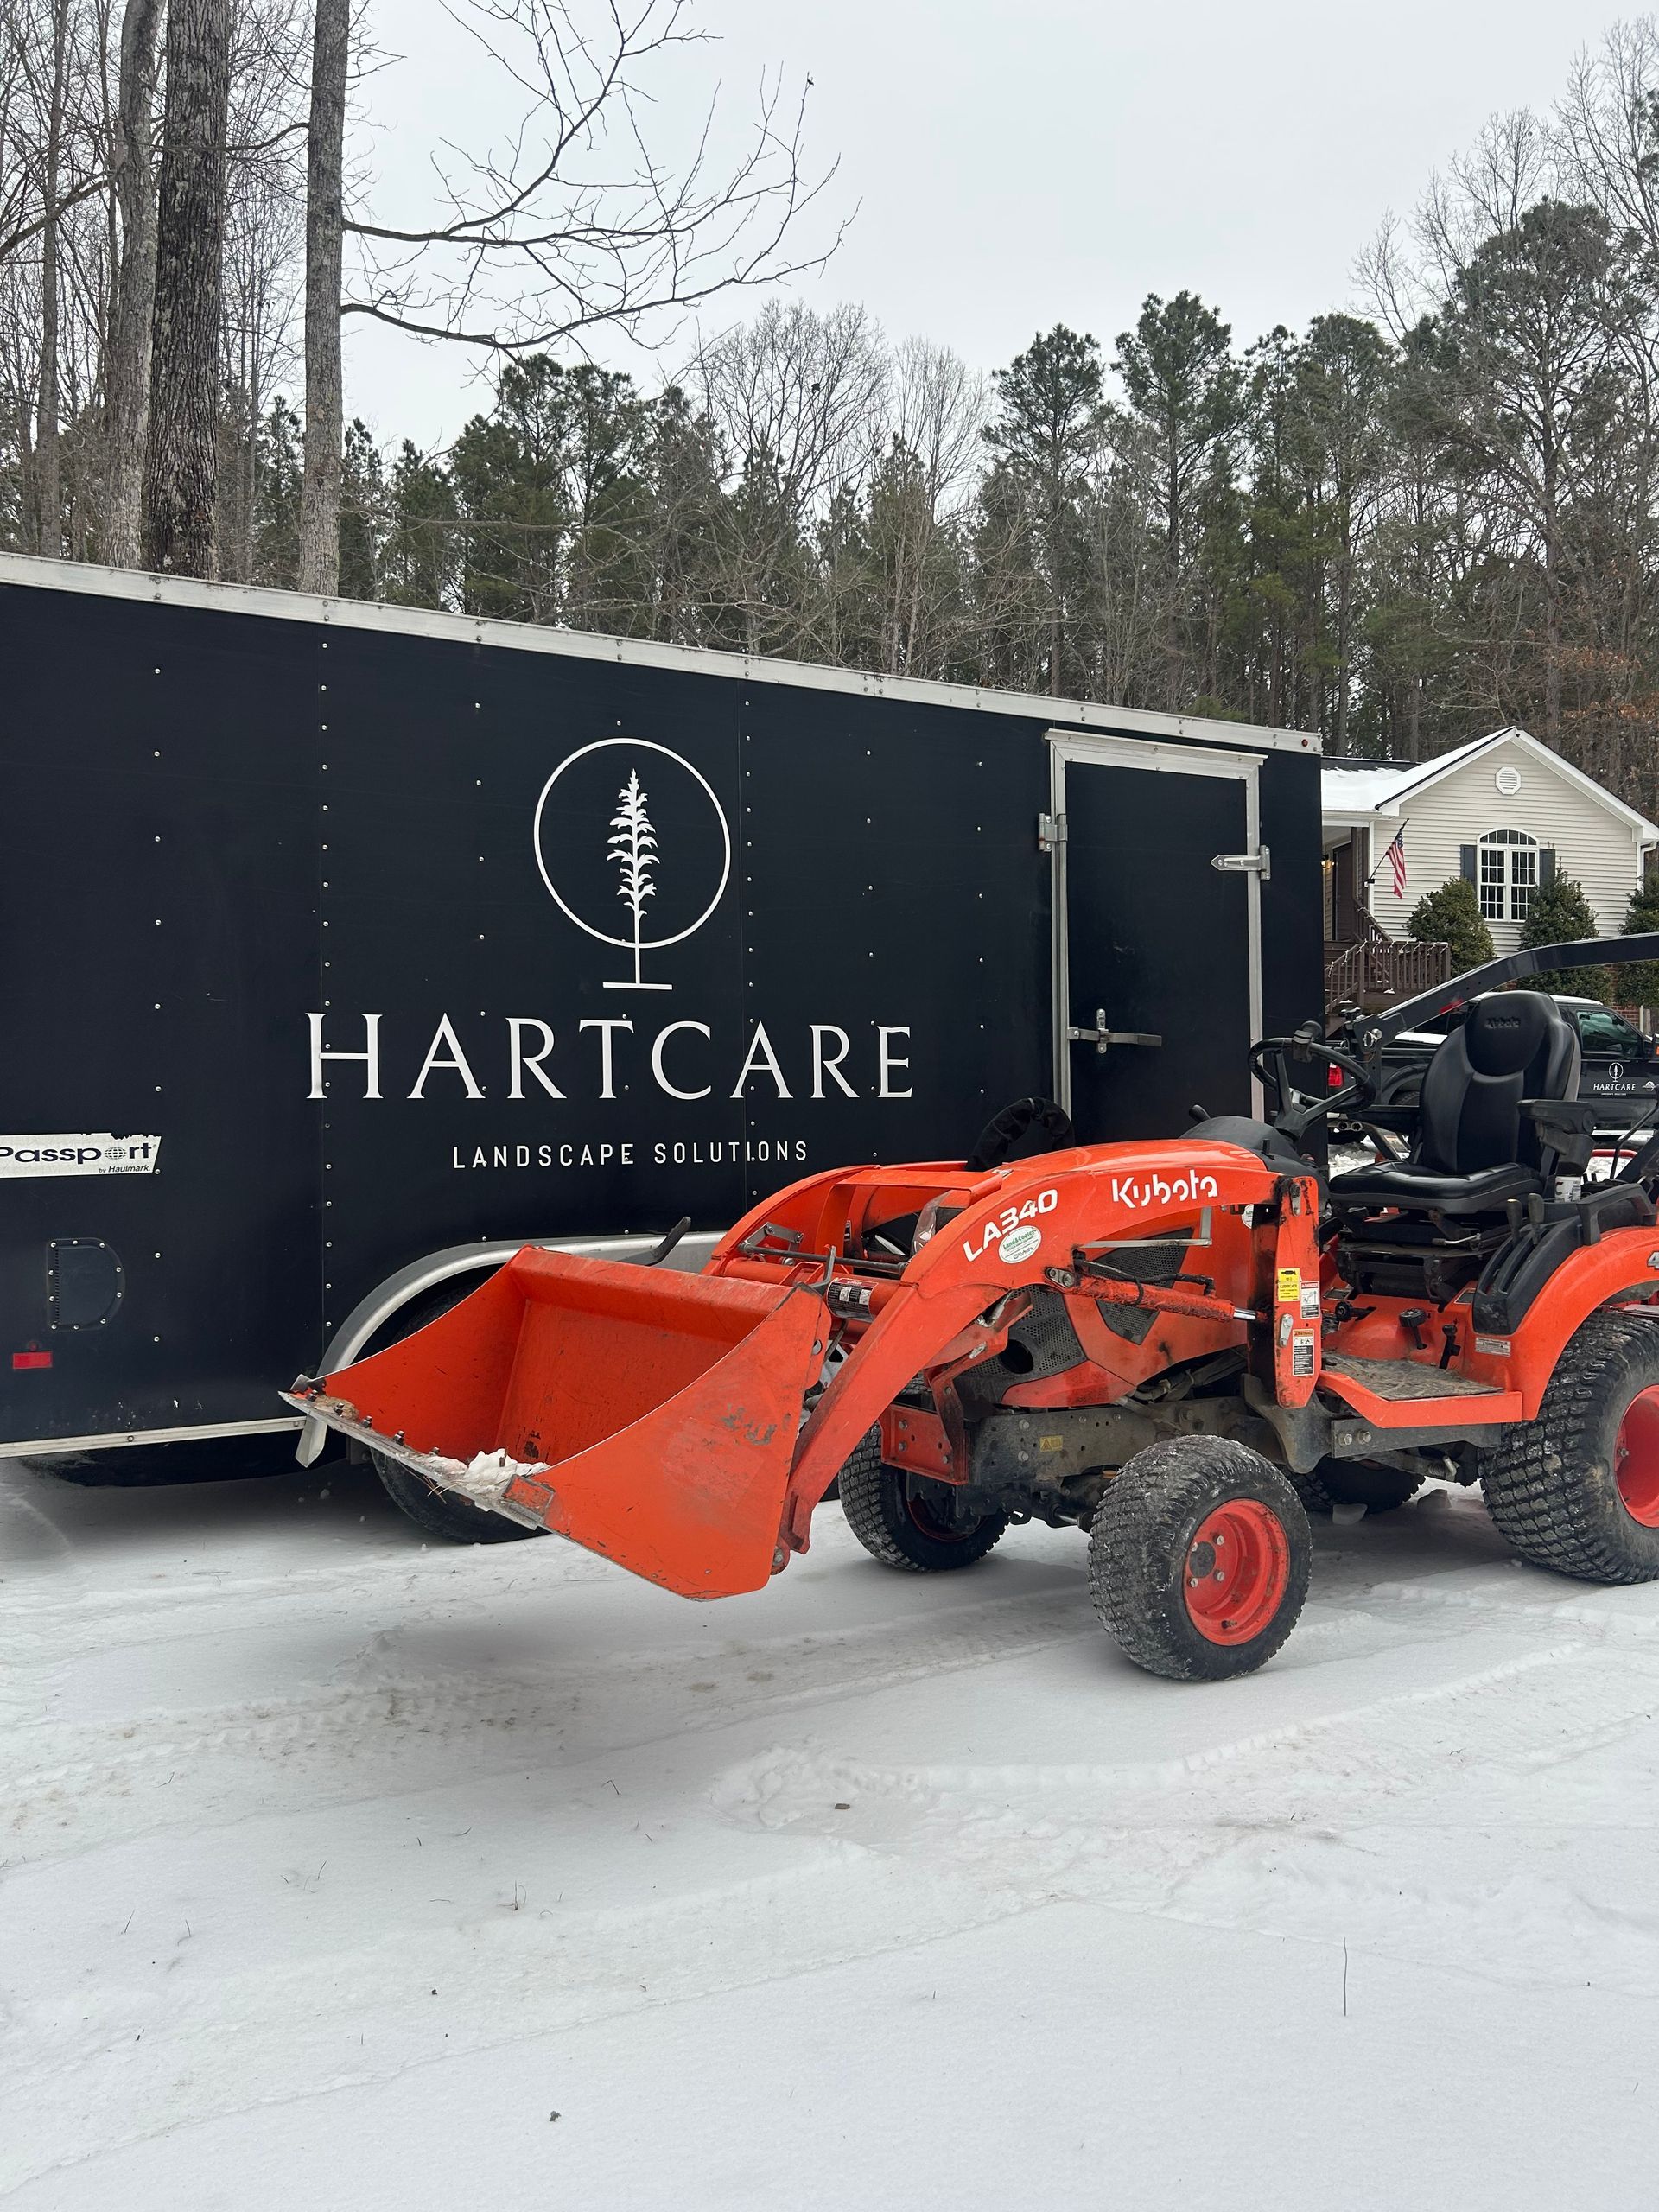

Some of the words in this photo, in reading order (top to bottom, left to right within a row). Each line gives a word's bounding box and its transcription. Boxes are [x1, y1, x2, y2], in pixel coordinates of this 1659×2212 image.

[305, 1012, 913, 1100] HARTCARE
[1593, 1083, 1636, 1091] HARTCARE
[453, 1144, 634, 1169] LANDSCAPE
[654, 1141, 807, 1164] SOLUTIONS
[1111, 1169, 1218, 1209] Kubota
[963, 1189, 1058, 1262] LA340
